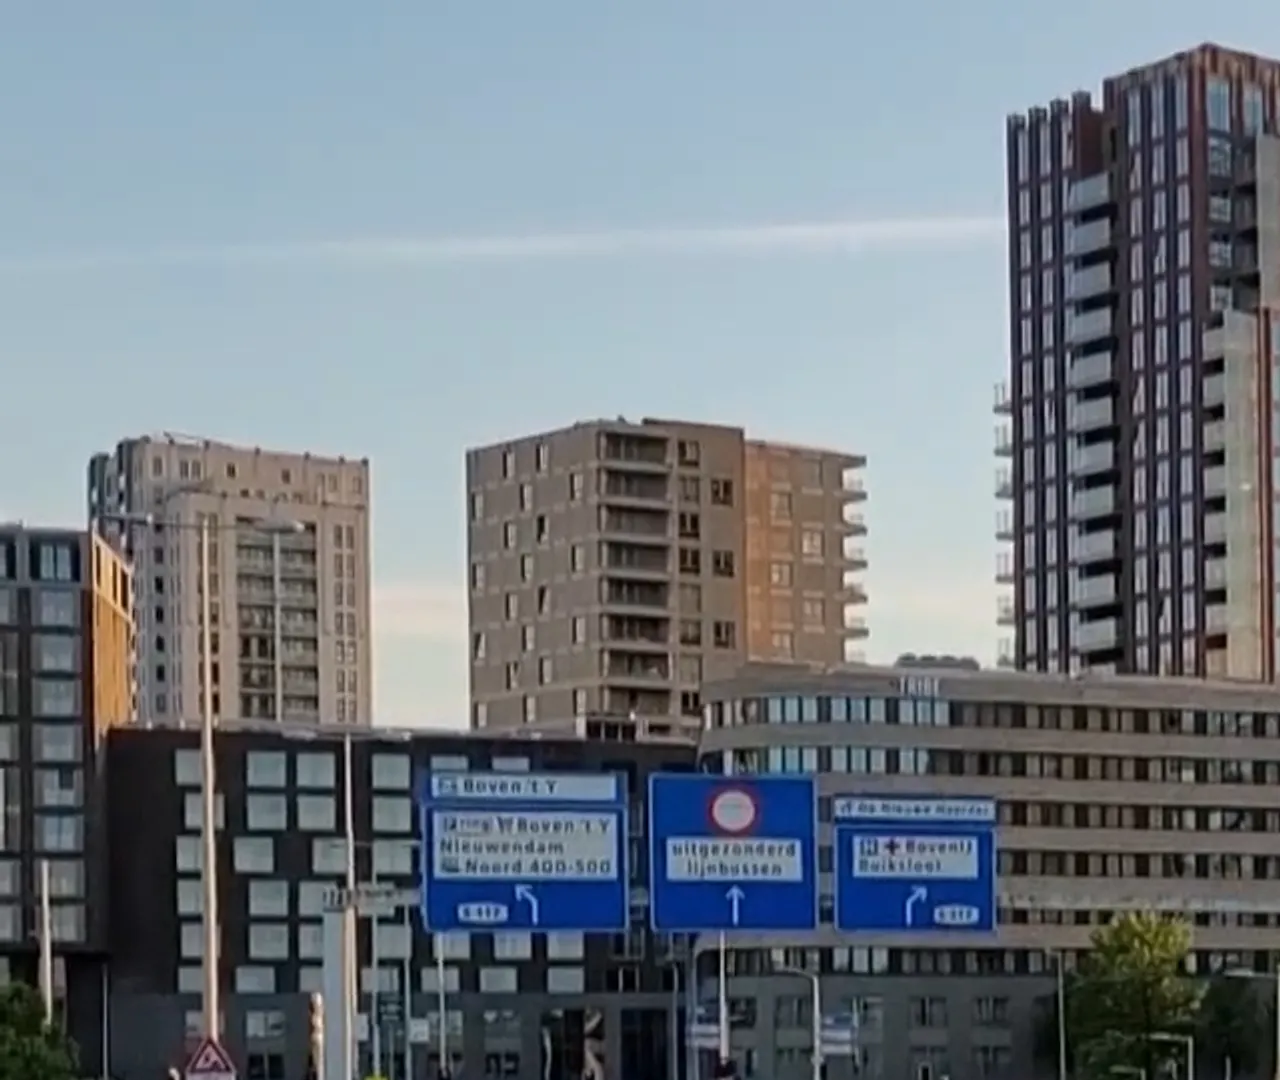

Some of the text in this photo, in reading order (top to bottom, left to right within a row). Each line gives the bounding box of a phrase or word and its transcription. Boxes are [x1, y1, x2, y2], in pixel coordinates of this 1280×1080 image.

[464, 778, 522, 794] Boven
[518, 816, 574, 833] Boven
[440, 838, 565, 854] Nieuwendam
[672, 841, 796, 858] uitgezonderd
[465, 858, 612, 874] Noord 400-500
[686, 860, 782, 877] lijnbussen
